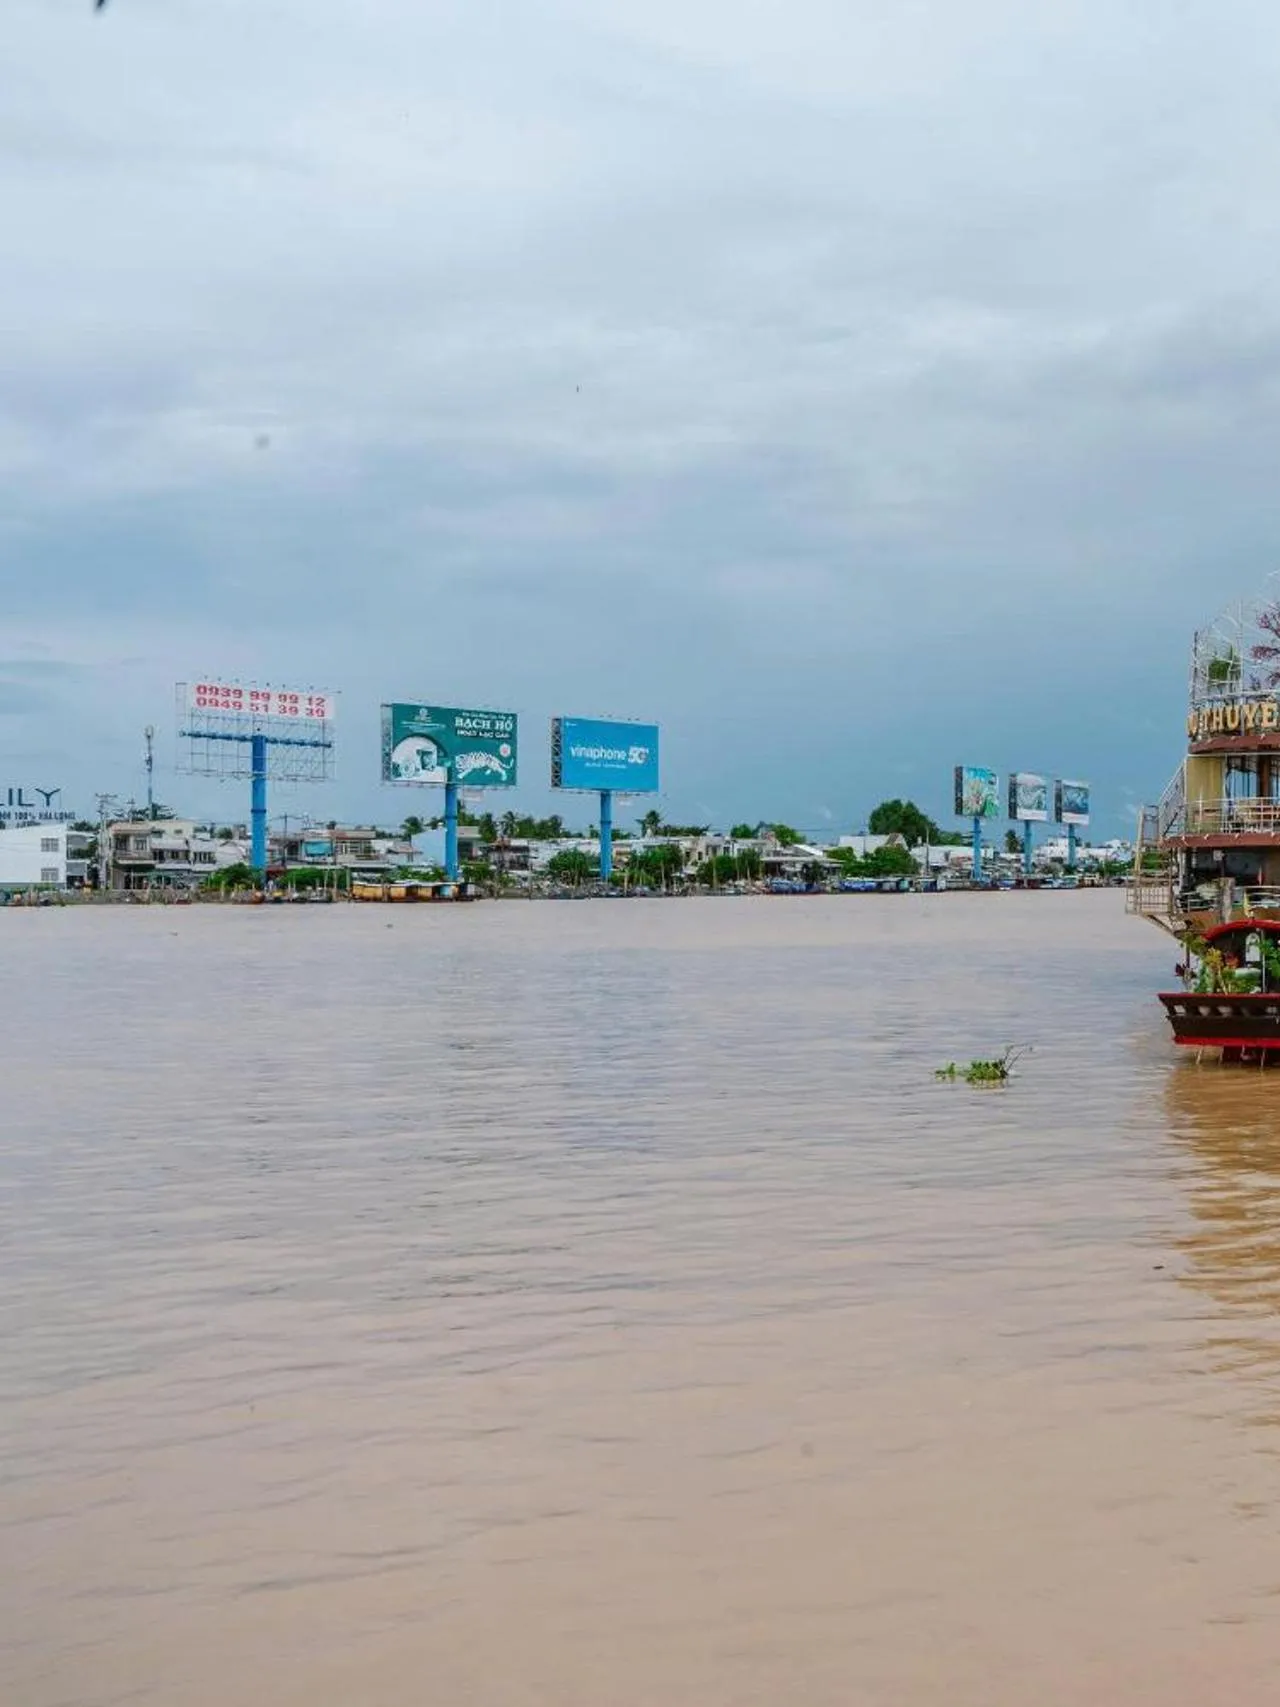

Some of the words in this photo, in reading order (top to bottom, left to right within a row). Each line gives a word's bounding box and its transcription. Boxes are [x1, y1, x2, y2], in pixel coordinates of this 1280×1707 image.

[196, 684, 243, 699] 0939
[249, 690, 271, 701] 99
[278, 693, 299, 704] 99
[306, 697, 326, 708] 12
[196, 698, 243, 711] 0949
[250, 703, 270, 713] 51
[278, 704, 299, 715] 39
[570, 745, 626, 761] vinaphone
